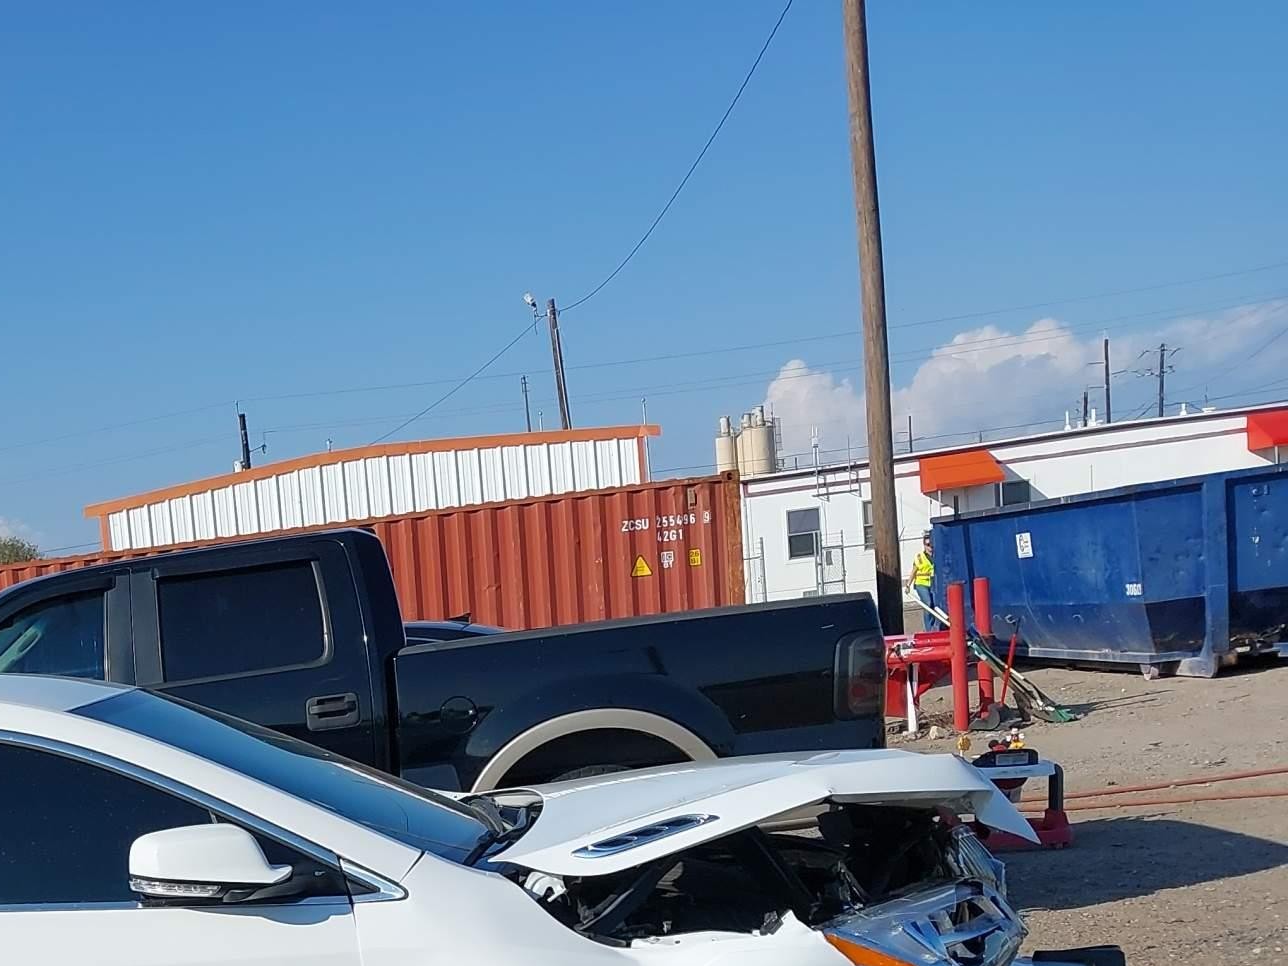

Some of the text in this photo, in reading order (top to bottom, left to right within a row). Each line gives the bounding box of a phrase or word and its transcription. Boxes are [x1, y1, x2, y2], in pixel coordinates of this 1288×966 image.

[621, 518, 649, 532] ZCSU
[656, 513, 696, 528] 255496
[657, 529, 683, 542] 42G1
